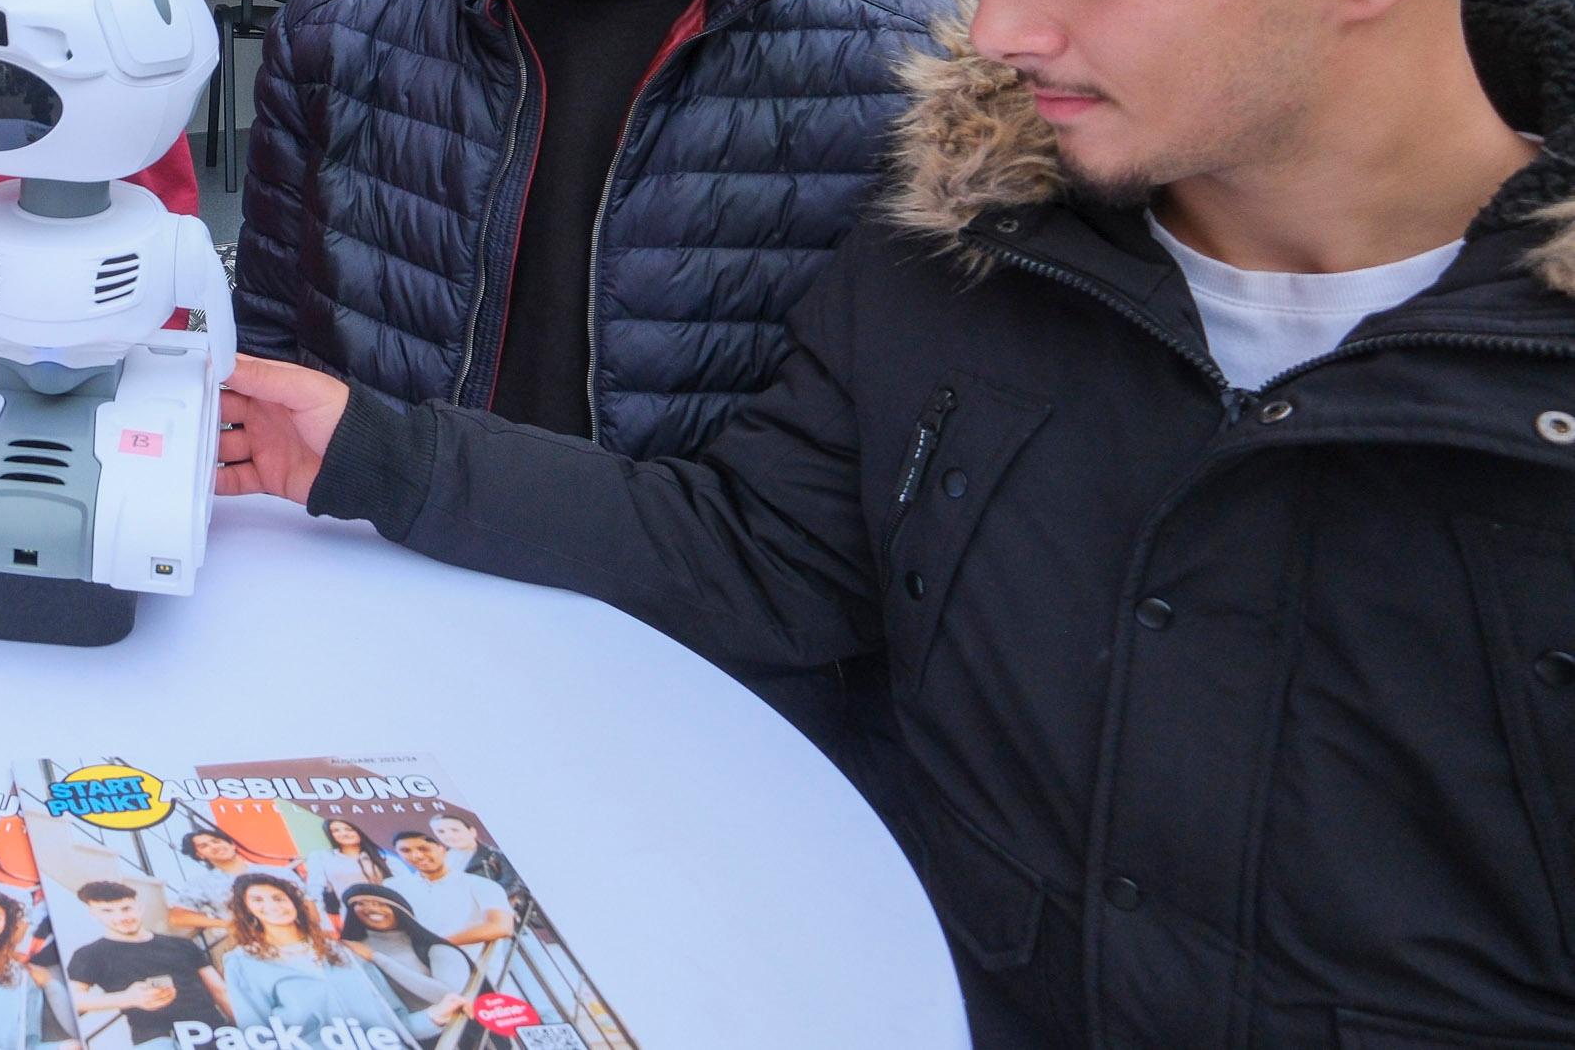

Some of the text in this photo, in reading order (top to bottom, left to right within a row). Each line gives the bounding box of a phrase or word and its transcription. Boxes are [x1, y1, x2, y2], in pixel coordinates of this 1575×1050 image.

[49, 775, 144, 799] START
[160, 774, 440, 802] AUSBILDUNG
[45, 792, 152, 817] PUNKT
[173, 1015, 402, 1050] Pack die
